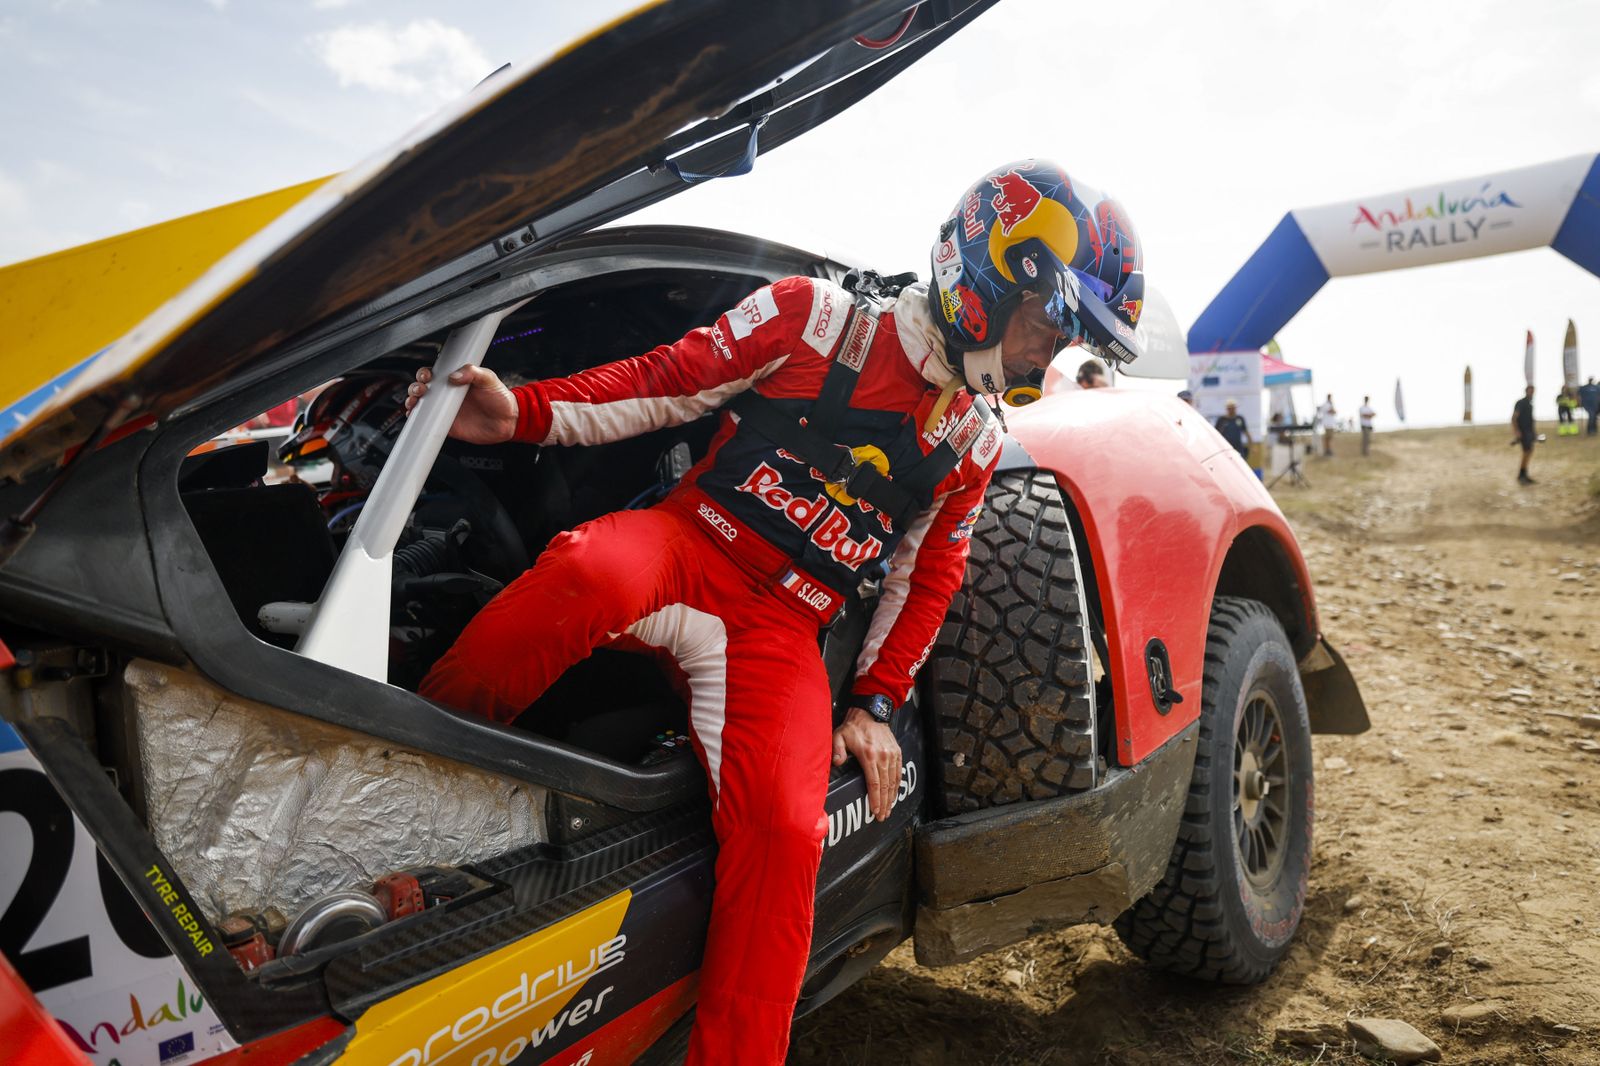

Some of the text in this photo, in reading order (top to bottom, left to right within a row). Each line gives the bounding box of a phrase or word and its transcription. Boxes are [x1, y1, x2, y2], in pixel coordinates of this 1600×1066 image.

[1386, 217, 1486, 252] RALLY
[847, 317, 870, 363] SIMPSON
[697, 503, 738, 542] sparco
[734, 461, 883, 572] Red Bull
[797, 582, 832, 612] S.LOEB
[144, 864, 214, 957] TYRE REPAIR
